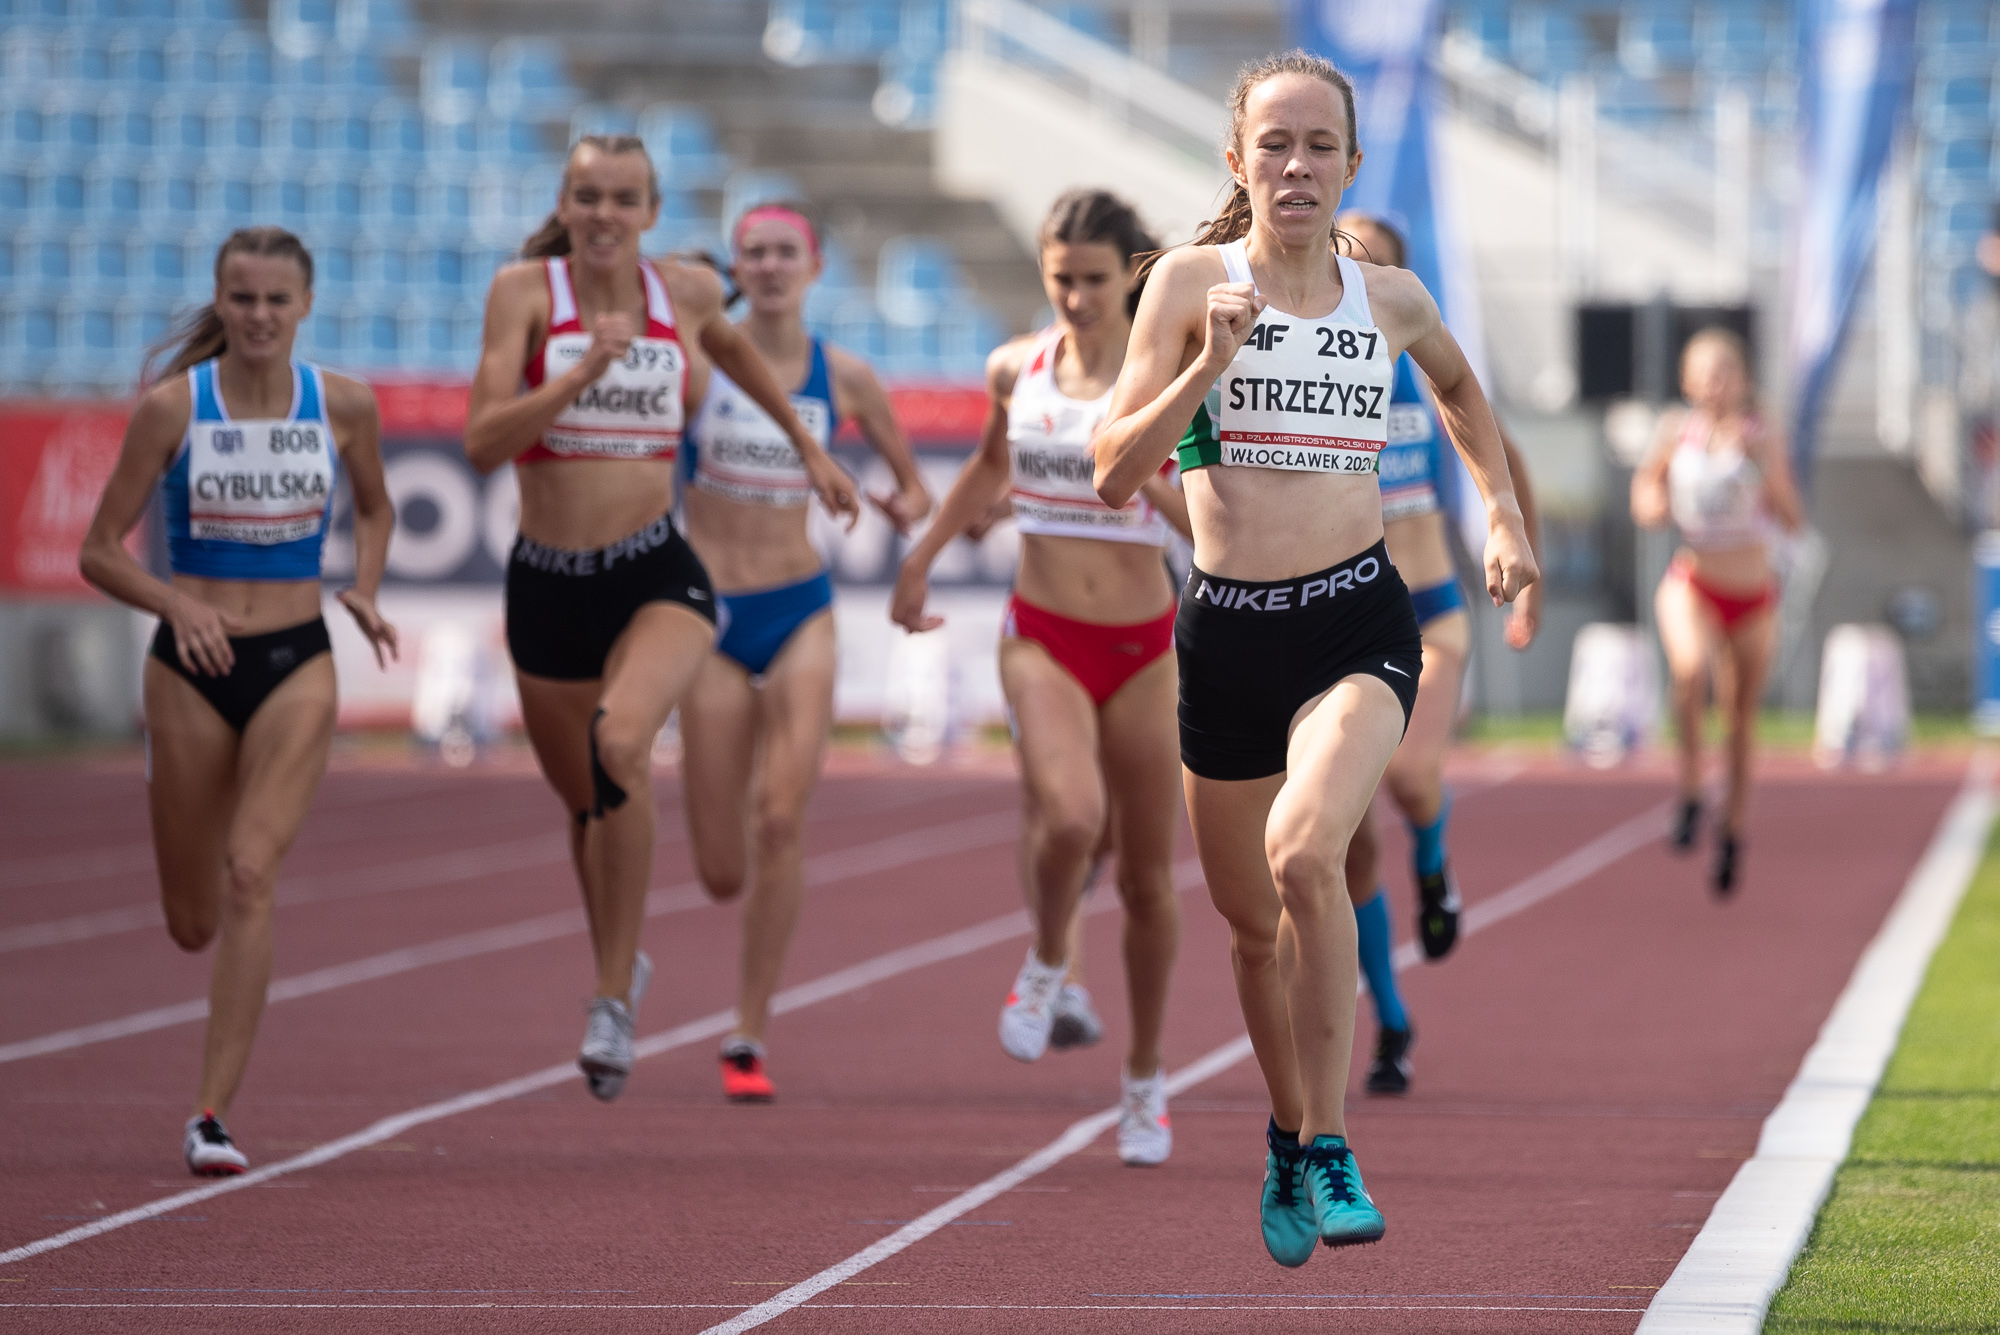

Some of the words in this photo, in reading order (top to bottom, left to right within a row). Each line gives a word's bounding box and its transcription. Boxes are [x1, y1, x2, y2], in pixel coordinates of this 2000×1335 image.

[1315, 326, 1378, 361] 287
[625, 346, 678, 372] 393
[1228, 373, 1384, 420] STRZEŻYSZ
[269, 427, 320, 454] 808
[1229, 433, 1245, 441] 53.
[1247, 434, 1272, 442] PZLA
[1272, 436, 1337, 447] MISTRZOSTWA
[1337, 440, 1365, 449] POLSKI
[1366, 442, 1382, 450] U18
[1230, 447, 1340, 470] WŁOCŁAWEK
[196, 471, 326, 501] CYBULSKA
[515, 537, 598, 577] NIKE
[602, 517, 670, 571] PRO
[1194, 579, 1294, 612] NIKE
[1299, 556, 1380, 607] PRO
